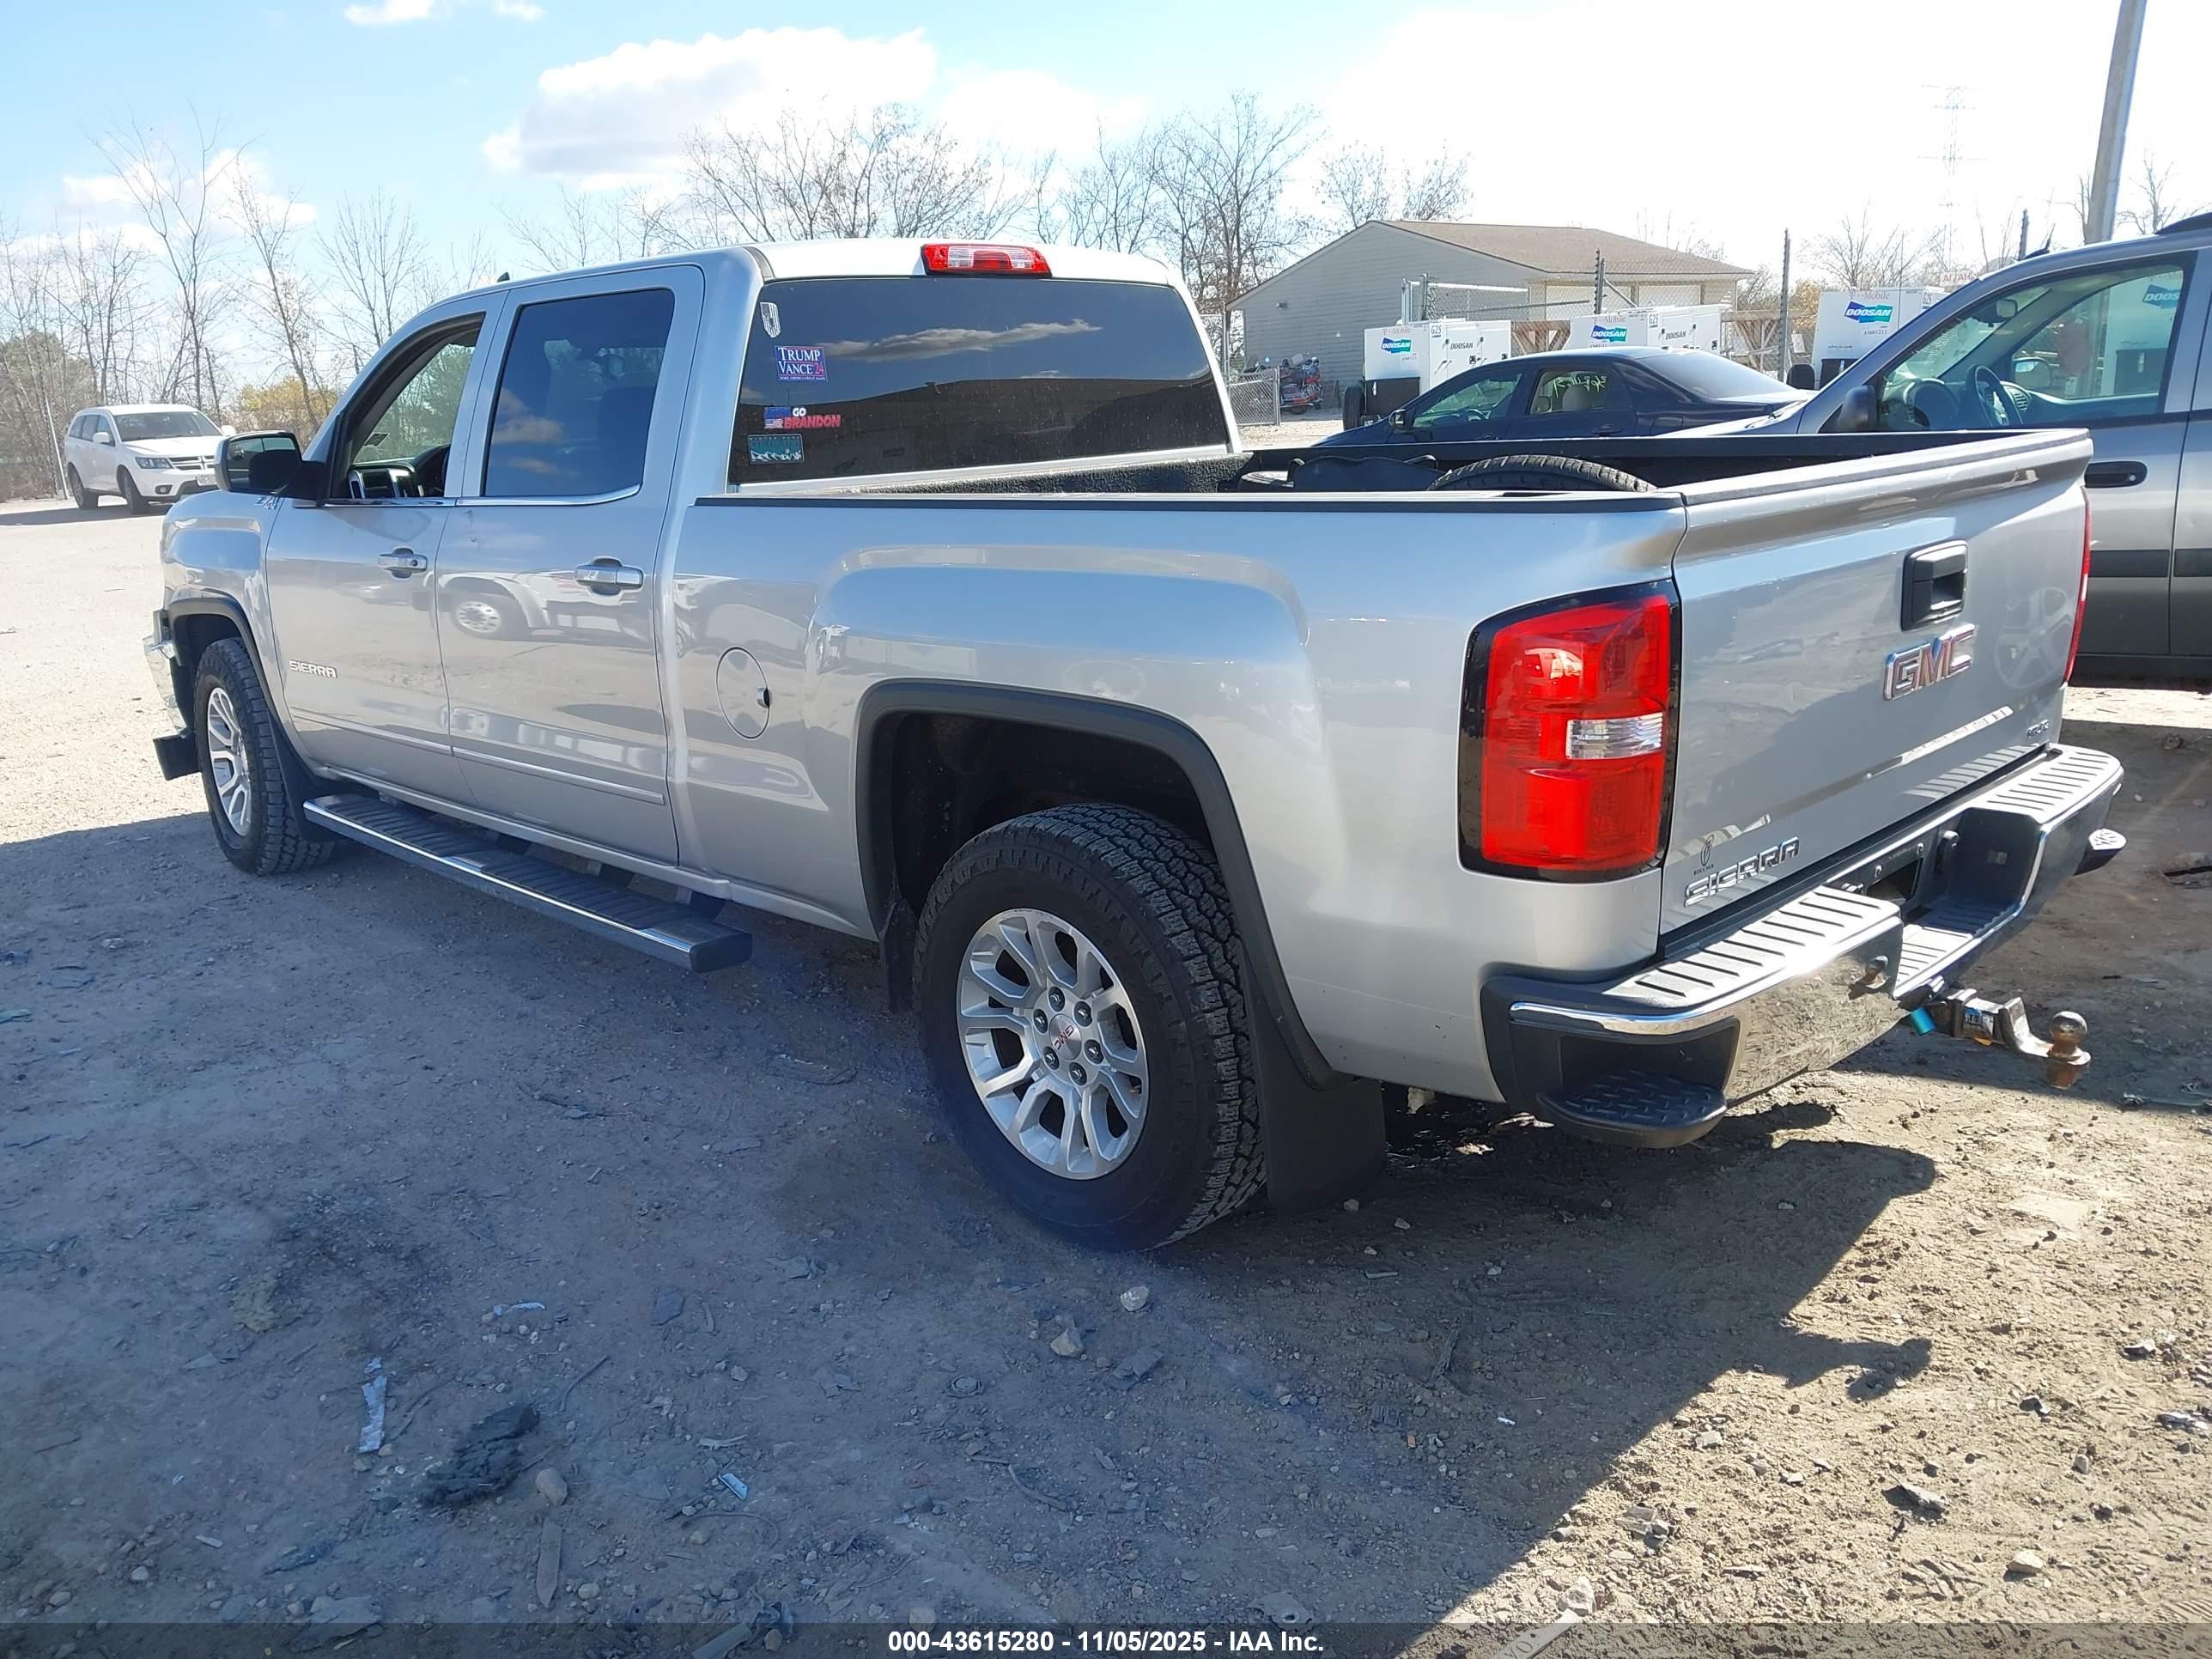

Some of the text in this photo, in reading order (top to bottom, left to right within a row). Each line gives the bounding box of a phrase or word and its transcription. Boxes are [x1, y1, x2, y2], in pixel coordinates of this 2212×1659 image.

[2143, 293, 2180, 301] DOOS
[1845, 308, 1892, 317] DOOSAN
[777, 347, 821, 362] TRUMP
[778, 361, 813, 374] VANCE
[792, 407, 807, 417] GO
[783, 415, 842, 429] BRANDON
[289, 659, 337, 679] SIERRA
[1883, 623, 1976, 701] GMC
[1683, 836, 1800, 908] SIERRA
[1054, 1024, 1074, 1051] GMC
